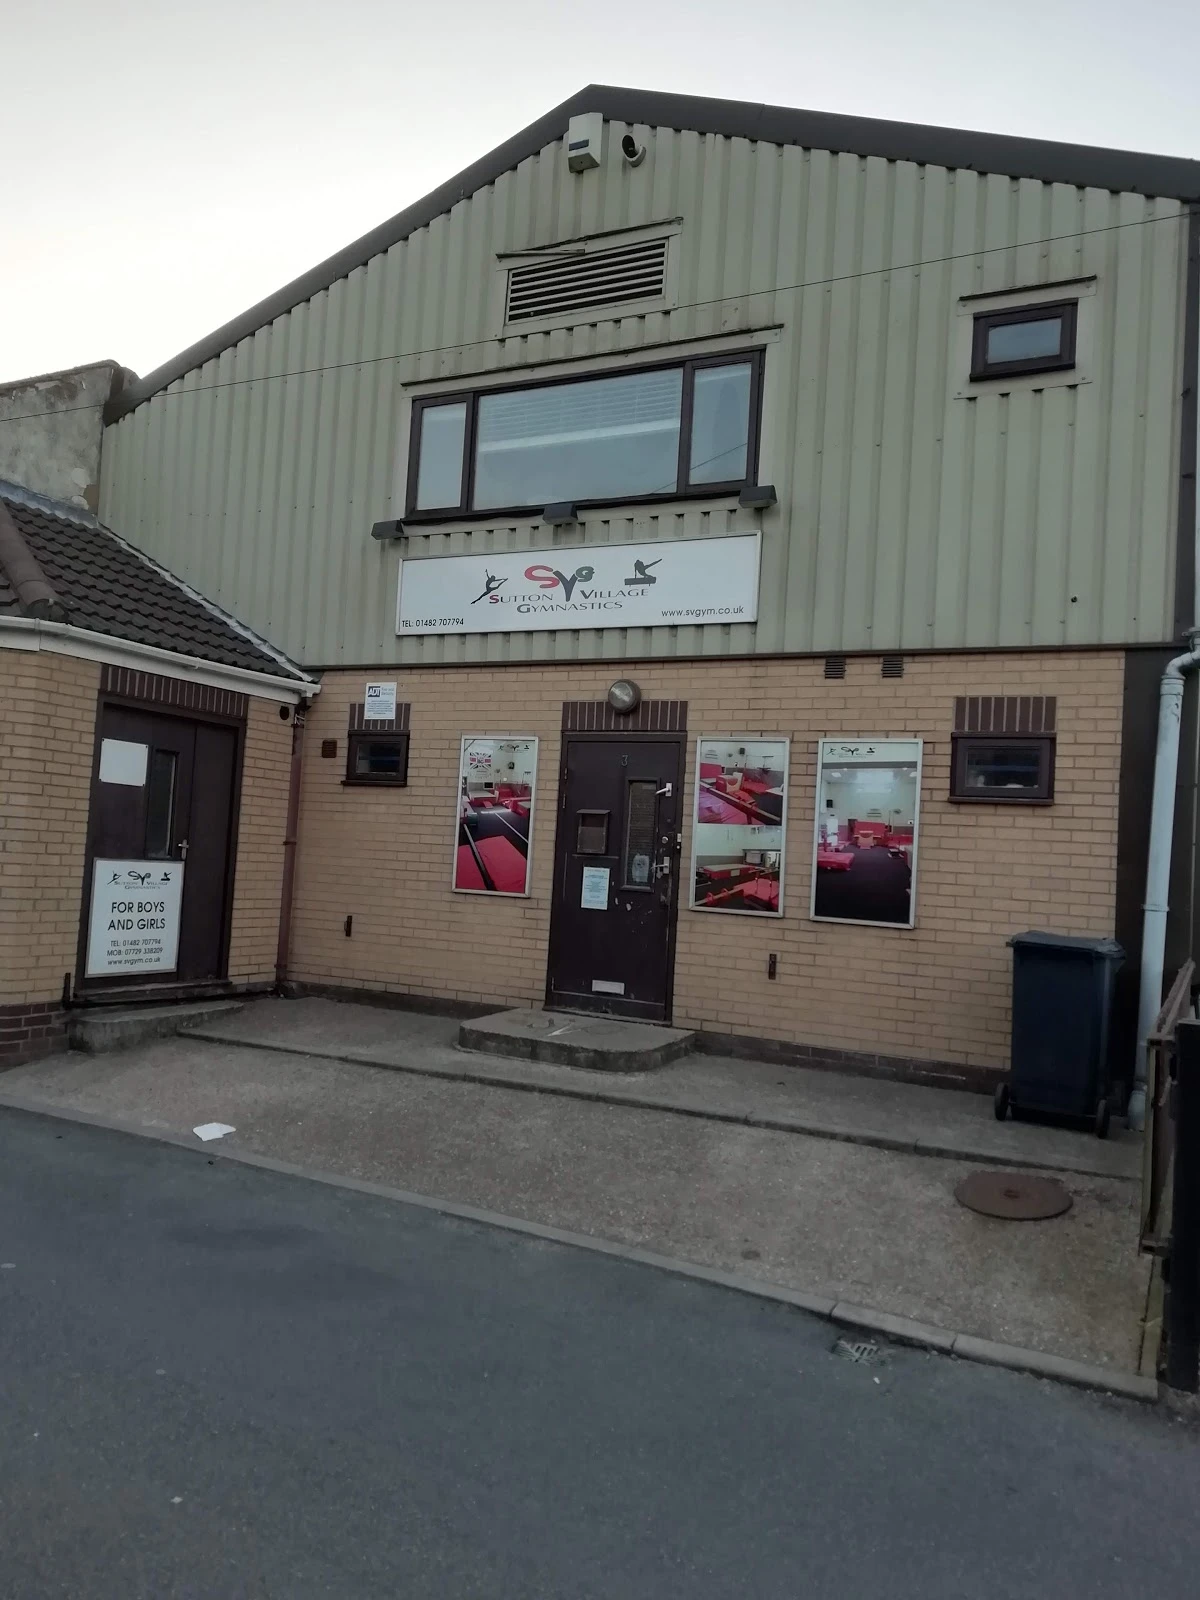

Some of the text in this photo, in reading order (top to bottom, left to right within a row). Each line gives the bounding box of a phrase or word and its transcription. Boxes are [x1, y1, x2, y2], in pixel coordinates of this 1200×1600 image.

[489, 588, 649, 604] SUTTON VILLAGE
[517, 601, 623, 613] GYMNASTICS
[661, 605, 744, 617] www.svgym.co.uk
[415, 619, 437, 627] 01482
[439, 617, 464, 626] 707794
[368, 686, 381, 697] ADT
[622, 754, 628, 766] 3
[111, 901, 165, 913] FOR BOYS
[107, 918, 166, 931] AND GIRLS
